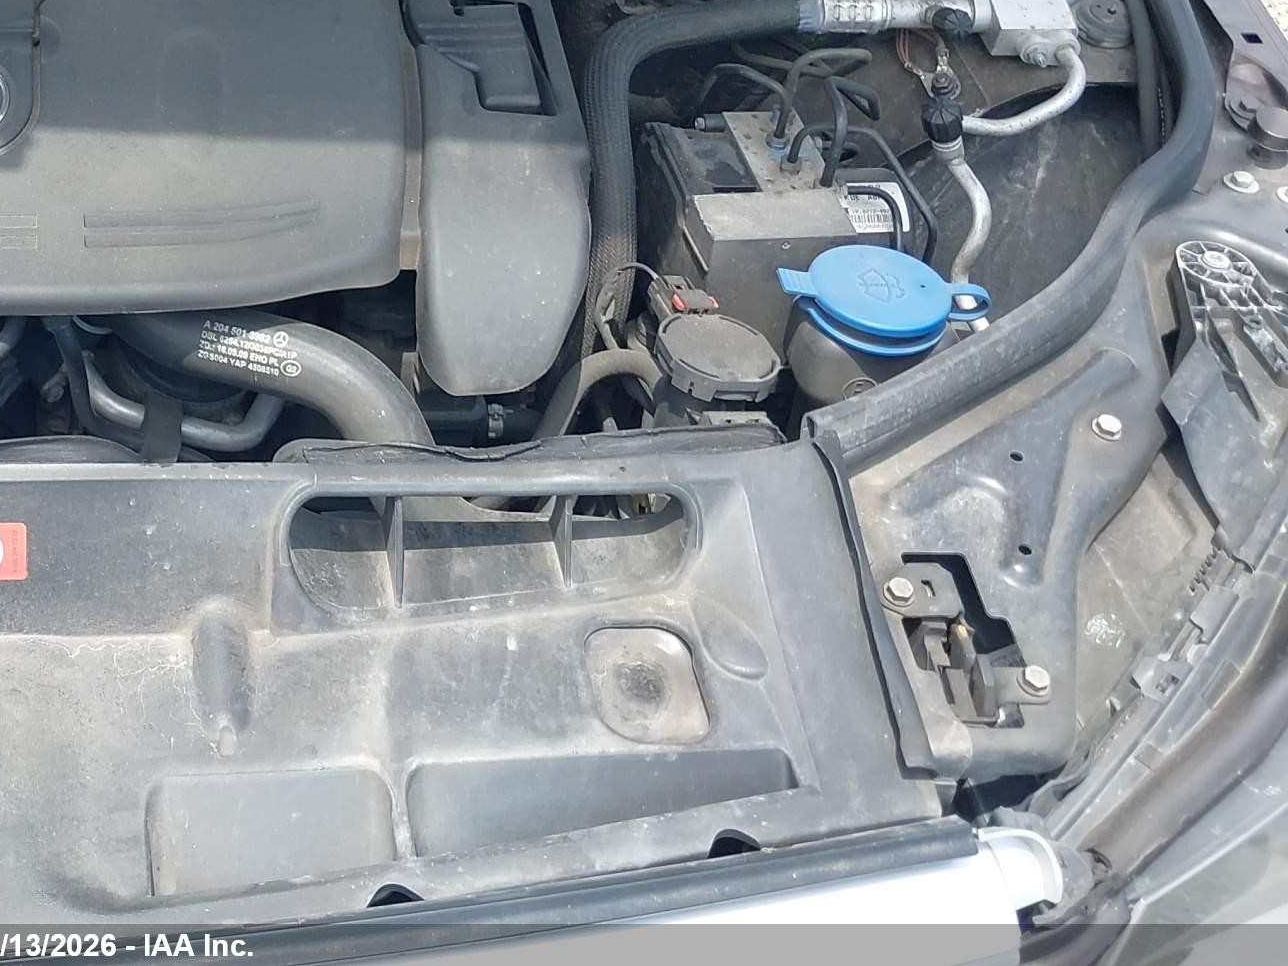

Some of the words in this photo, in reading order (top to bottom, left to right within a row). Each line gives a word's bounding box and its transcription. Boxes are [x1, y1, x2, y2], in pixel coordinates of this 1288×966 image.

[203, 320, 211, 329] A
[213, 322, 229, 333] 204
[231, 326, 246, 338] 501
[229, 358, 247, 368] YAP
